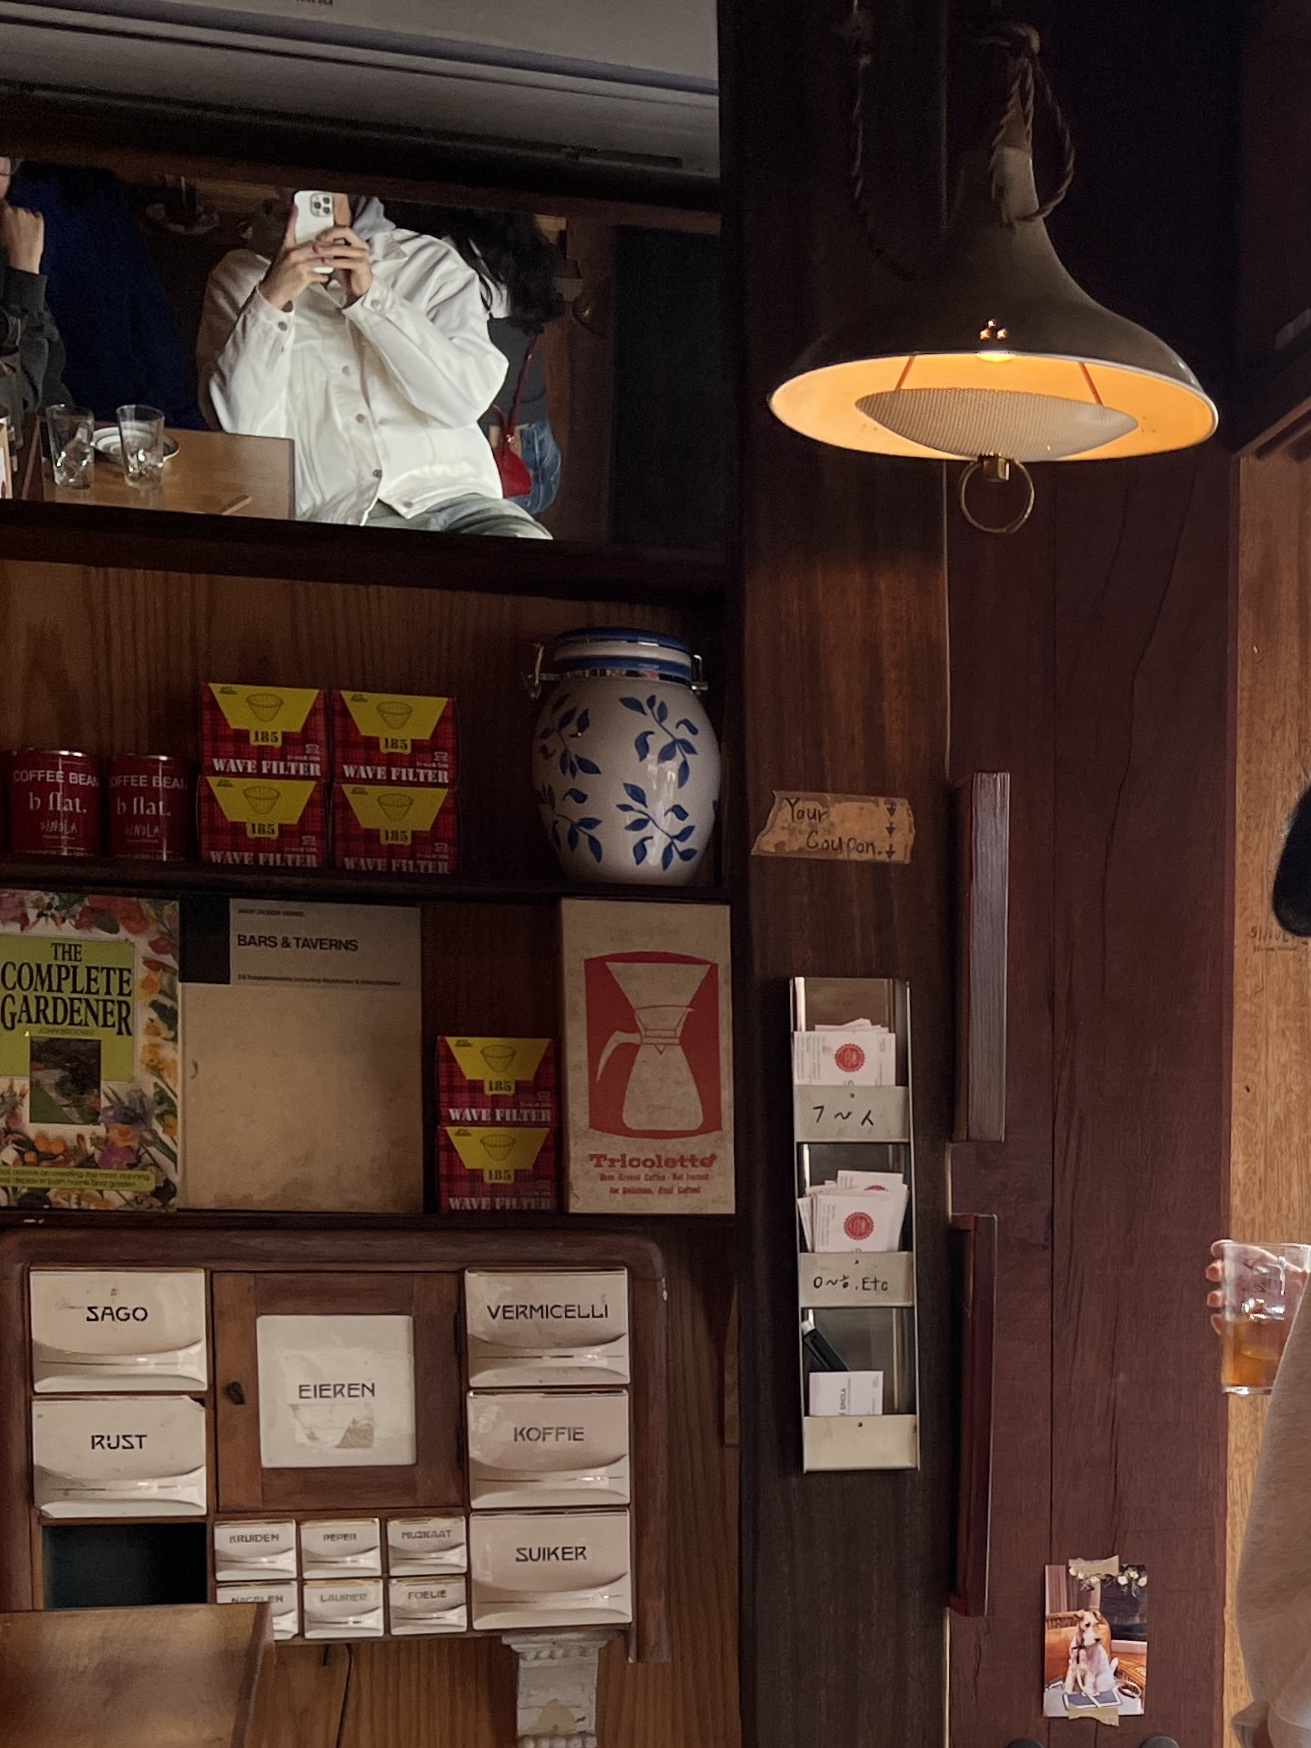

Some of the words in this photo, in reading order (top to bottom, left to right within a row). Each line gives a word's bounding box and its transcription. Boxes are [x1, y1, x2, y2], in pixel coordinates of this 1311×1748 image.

[253, 731, 278, 742] 185
[384, 738, 408, 750] 185
[212, 758, 257, 774] WAVE
[261, 760, 321, 776] FILTER
[343, 765, 387, 780] WAVE
[391, 767, 449, 783] FILTER
[13, 770, 65, 782] COFFEE
[29, 791, 41, 811] b
[117, 796, 127, 815] b
[785, 797, 829, 822] Your
[251, 823, 275, 835] 185
[384, 830, 408, 842] 185
[209, 850, 254, 866] WAVE
[258, 853, 318, 868] FILTER
[344, 857, 387, 871] WAVE
[391, 859, 450, 874] FILTER
[237, 934, 277, 948] BARS
[281, 936, 290, 949] &
[293, 937, 359, 952] TAVERNS
[51, 943, 82, 962] THE
[1, 961, 132, 996] COMPLETE
[1, 993, 132, 1036] GARDENER
[488, 1080, 511, 1091] 185
[449, 1108, 491, 1121] WAVE
[495, 1109, 551, 1122] FILTER
[488, 1170, 511, 1181] 185
[449, 1197, 491, 1210] WAVE
[495, 1198, 551, 1210] FILTER
[86, 1306, 148, 1321] SAGO
[487, 1304, 609, 1320] VERMICELLI
[299, 1382, 375, 1399] EIEREN
[513, 1427, 584, 1441] KOFFIE
[229, 1533, 279, 1544] KRUIDEN
[323, 1532, 357, 1542] PEPER
[401, 1529, 452, 1540] MUSKAAT
[515, 1546, 587, 1562] SUIKER
[408, 1590, 446, 1600] FOELIE
